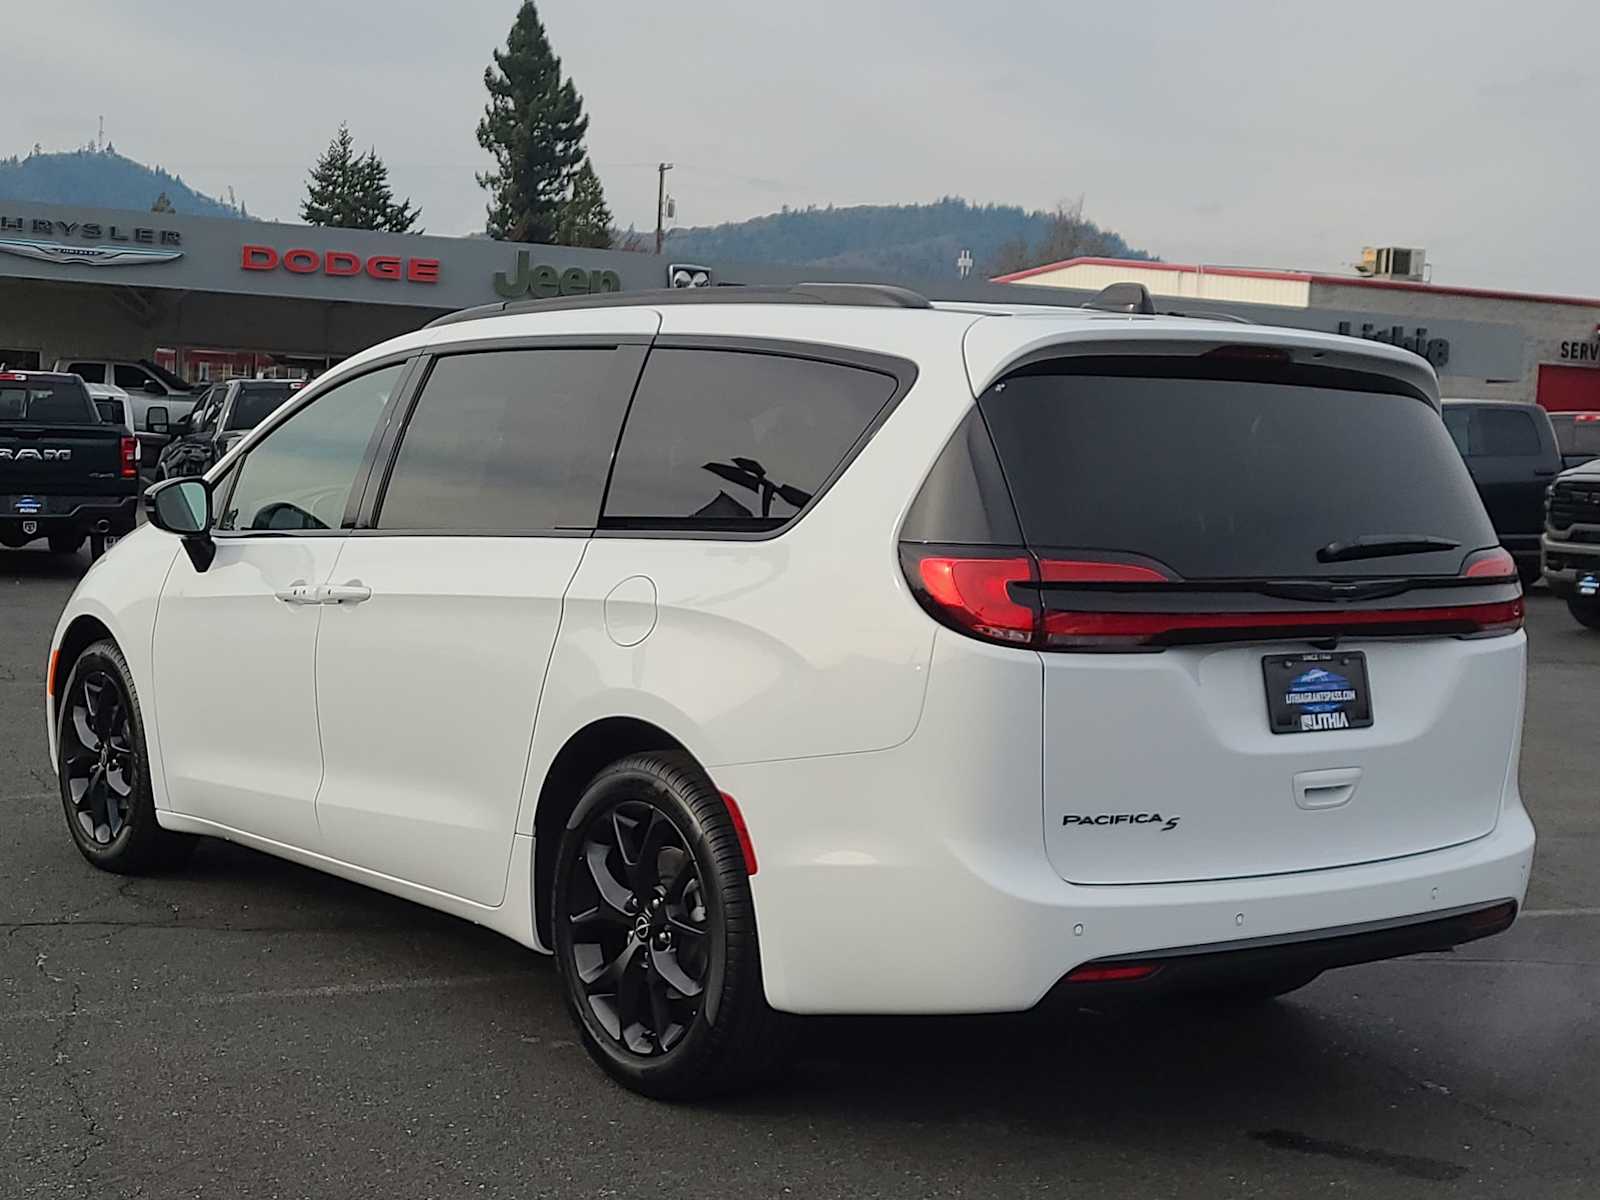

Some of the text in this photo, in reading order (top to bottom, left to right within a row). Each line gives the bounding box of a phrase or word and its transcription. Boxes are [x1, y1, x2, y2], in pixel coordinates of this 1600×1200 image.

[241, 245, 440, 284] DODGE
[1311, 711, 1349, 730] LITHIA
[1063, 814, 1180, 831] PACIFICA S
